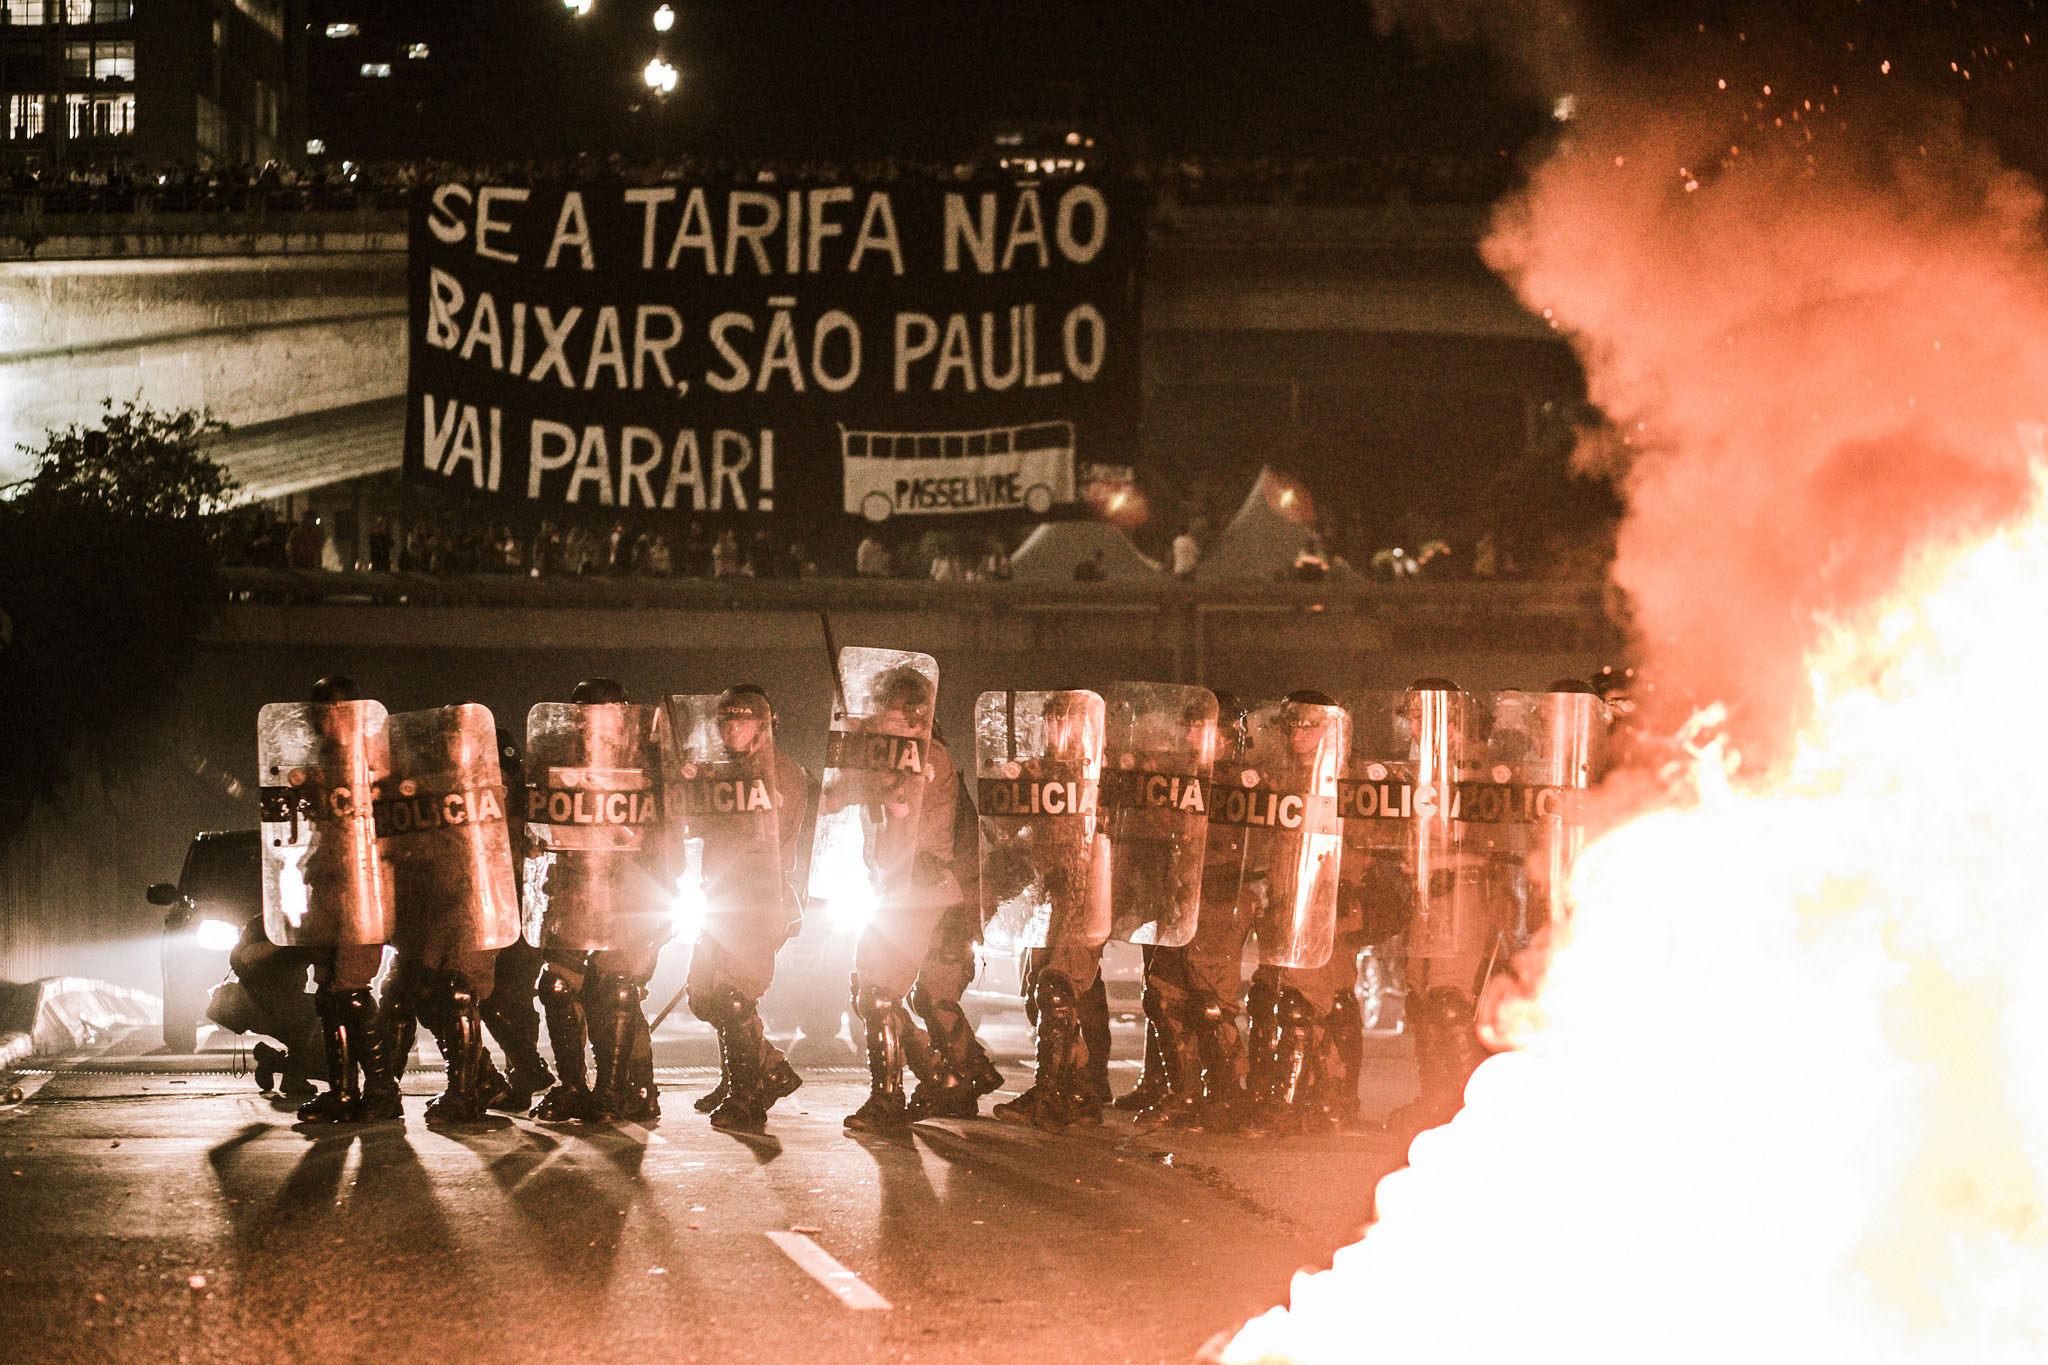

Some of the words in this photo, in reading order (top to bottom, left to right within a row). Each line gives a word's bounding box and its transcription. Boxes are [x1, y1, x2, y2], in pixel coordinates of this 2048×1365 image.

[427, 183, 530, 264] SE
[545, 192, 595, 270] A
[624, 187, 904, 276] TARIFA
[944, 181, 1108, 273] NÃO
[426, 267, 689, 397] BAIXAR,
[705, 297, 862, 393] SÃO
[894, 303, 1105, 393] PAULO
[424, 394, 500, 492] VAI
[528, 419, 774, 511] PARAR!
[378, 790, 503, 831] OLICIA
[528, 790, 661, 824] POLICIA
[984, 781, 1098, 815] OLICIA
